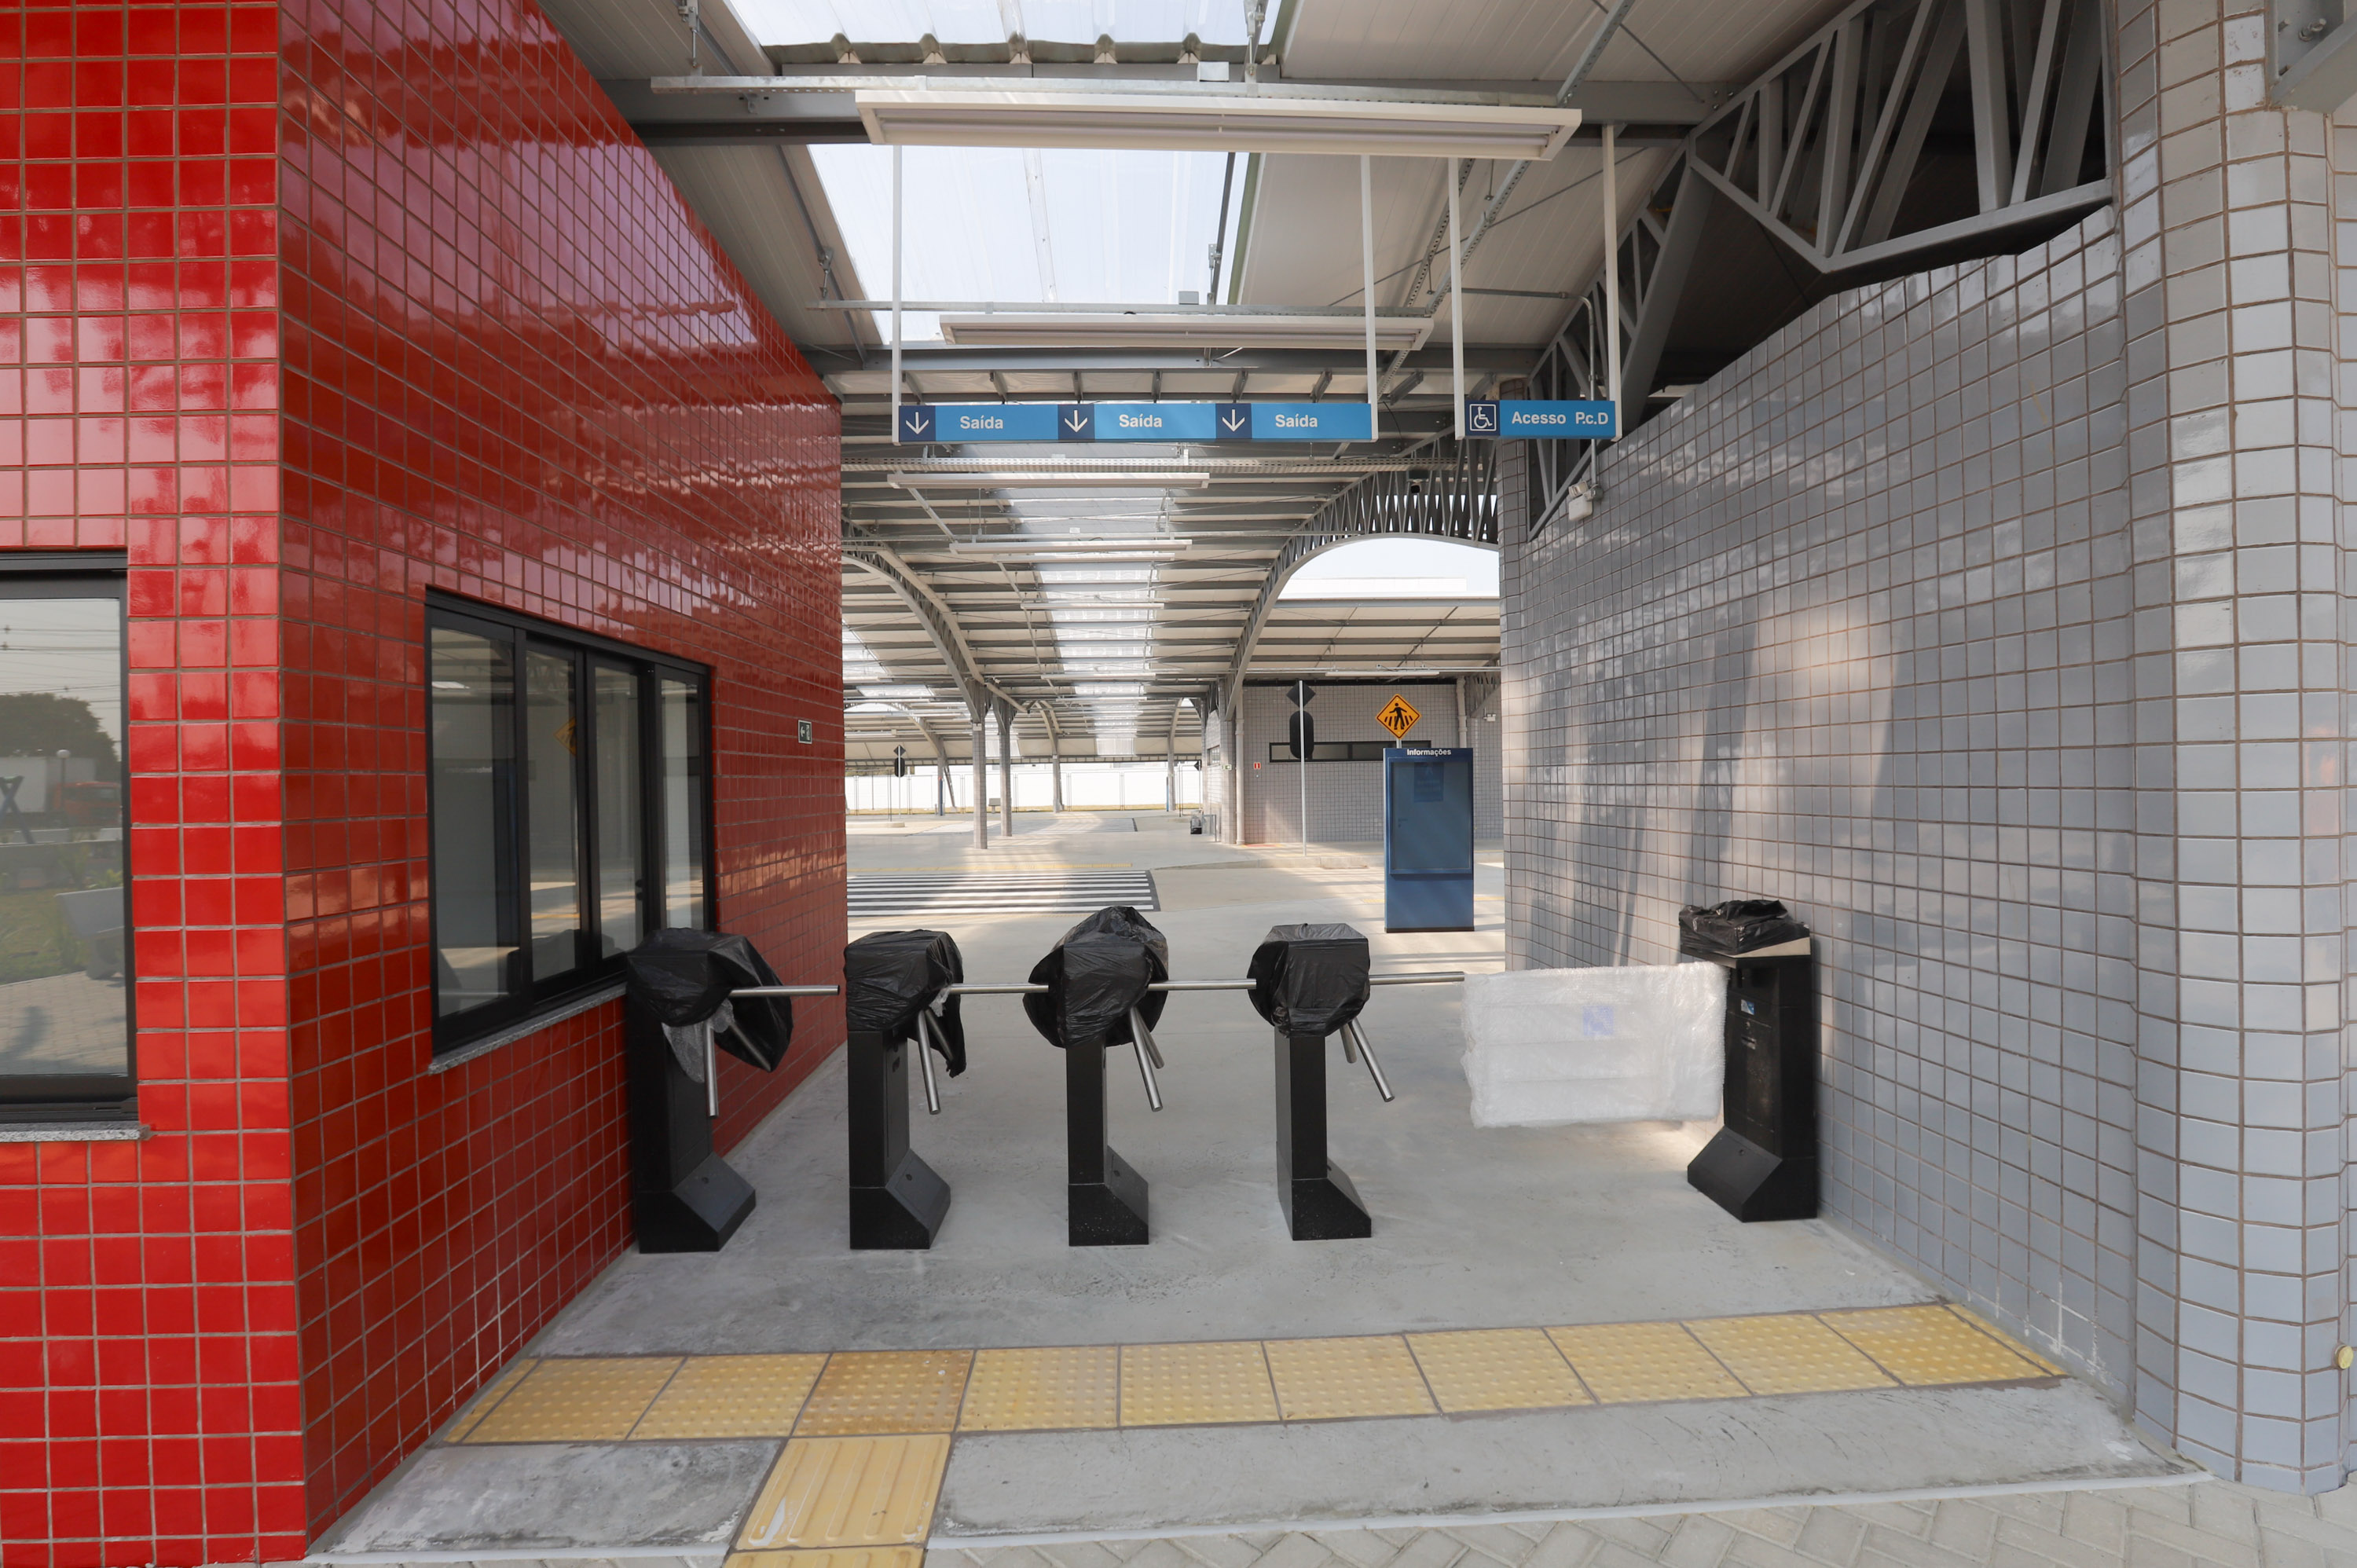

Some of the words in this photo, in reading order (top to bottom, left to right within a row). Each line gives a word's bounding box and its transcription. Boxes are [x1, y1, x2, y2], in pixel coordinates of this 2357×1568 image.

[959, 416, 1003, 430] Saída
[1119, 413, 1163, 428] Saída
[1275, 413, 1318, 428] Saída
[1511, 411, 1567, 425] Acesso
[1575, 411, 1609, 425] P.c.D
[1406, 748, 1452, 757] Informações
